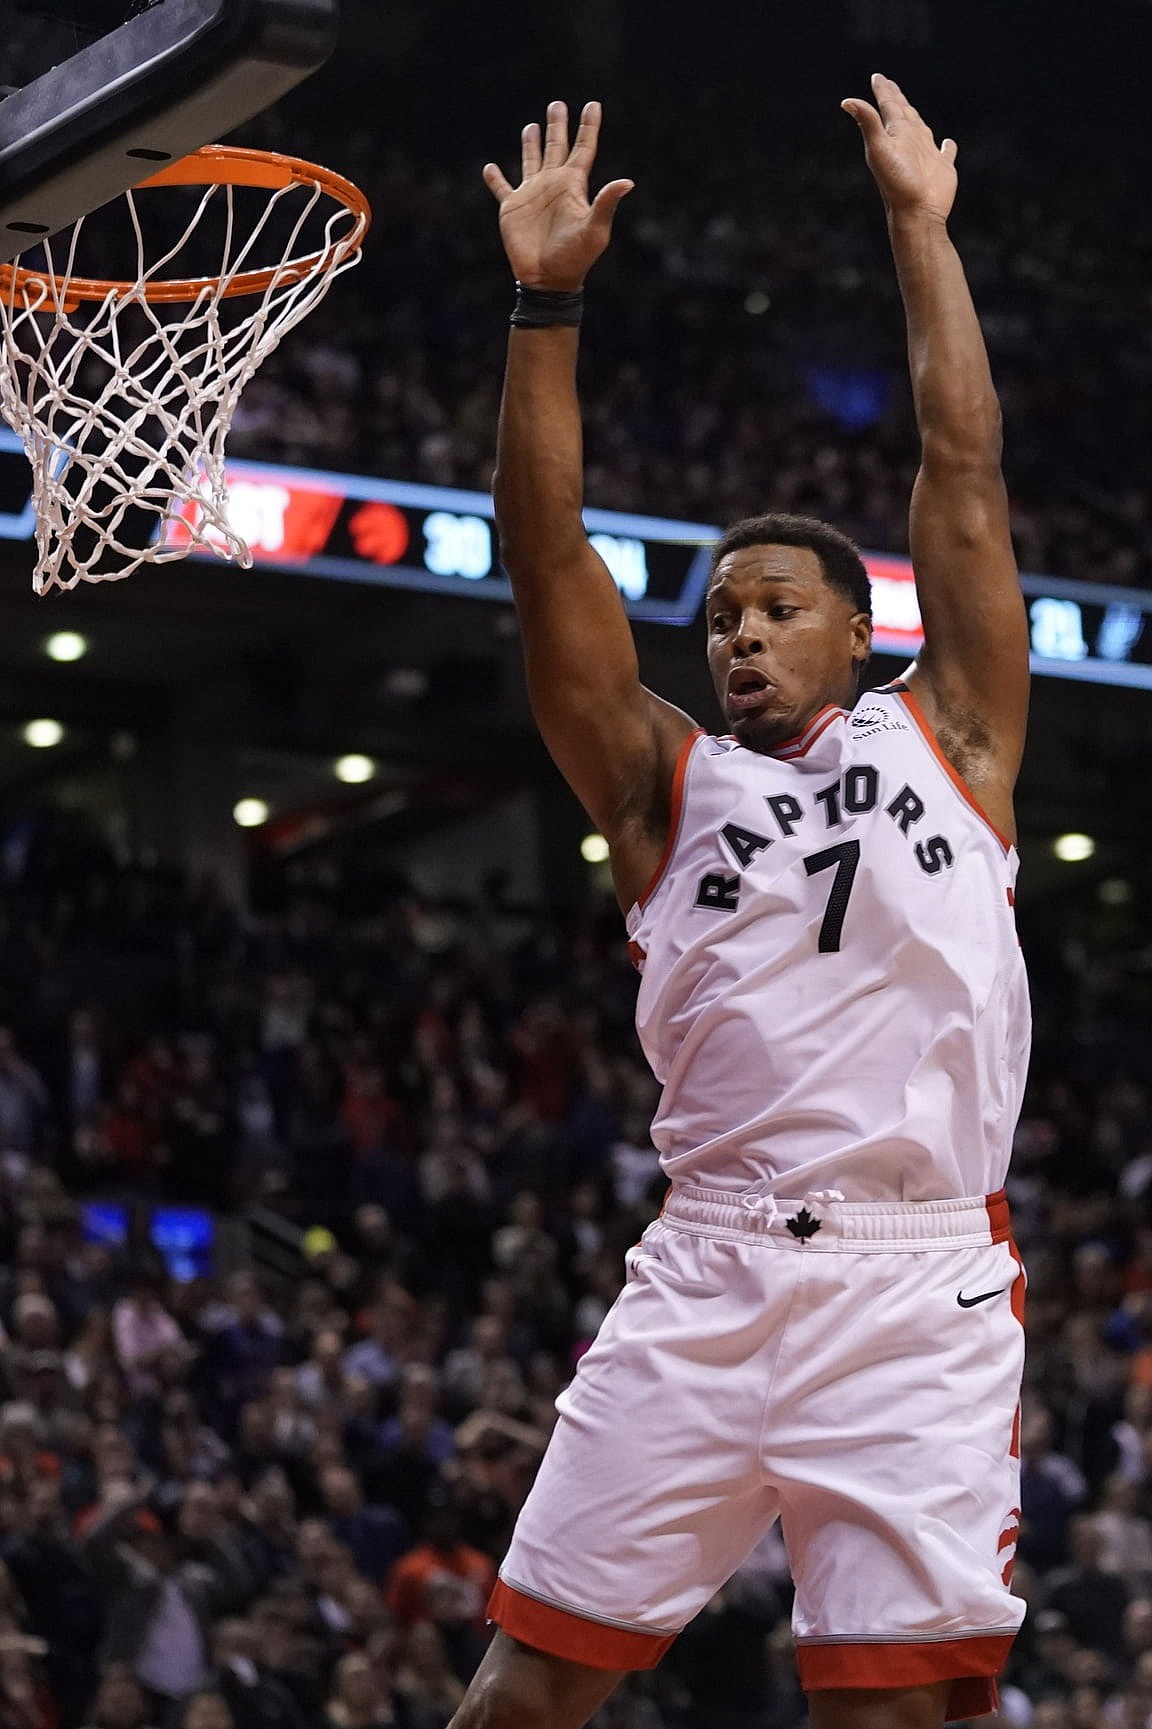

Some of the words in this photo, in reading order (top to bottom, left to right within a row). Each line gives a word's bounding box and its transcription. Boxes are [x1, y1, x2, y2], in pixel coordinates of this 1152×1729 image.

[852, 727, 882, 741] Sun
[693, 763, 956, 913] RAPTORS
[803, 838, 860, 954] 7
